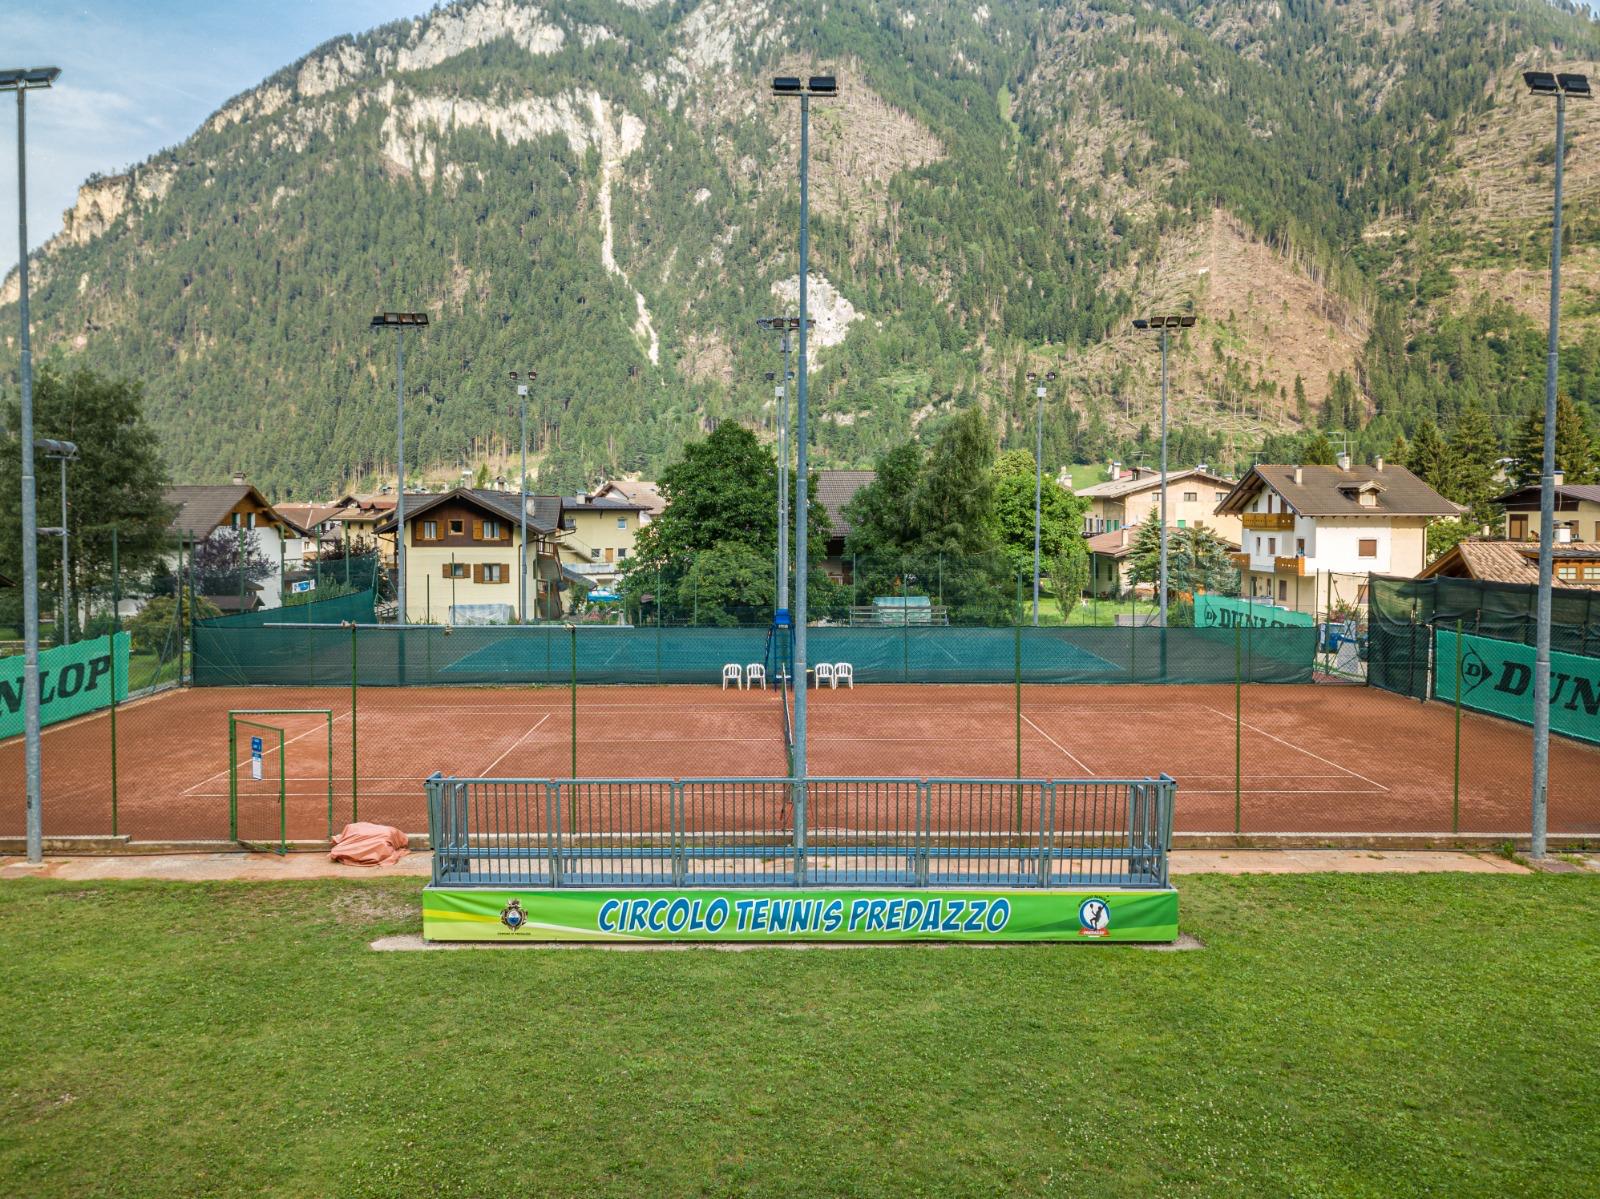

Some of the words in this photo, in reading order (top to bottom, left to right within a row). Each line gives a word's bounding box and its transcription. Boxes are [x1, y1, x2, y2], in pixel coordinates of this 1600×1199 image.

[598, 897, 729, 933] CIRCOLO
[735, 898, 844, 934] TENNIS
[848, 898, 1011, 933] PREDAZZO
